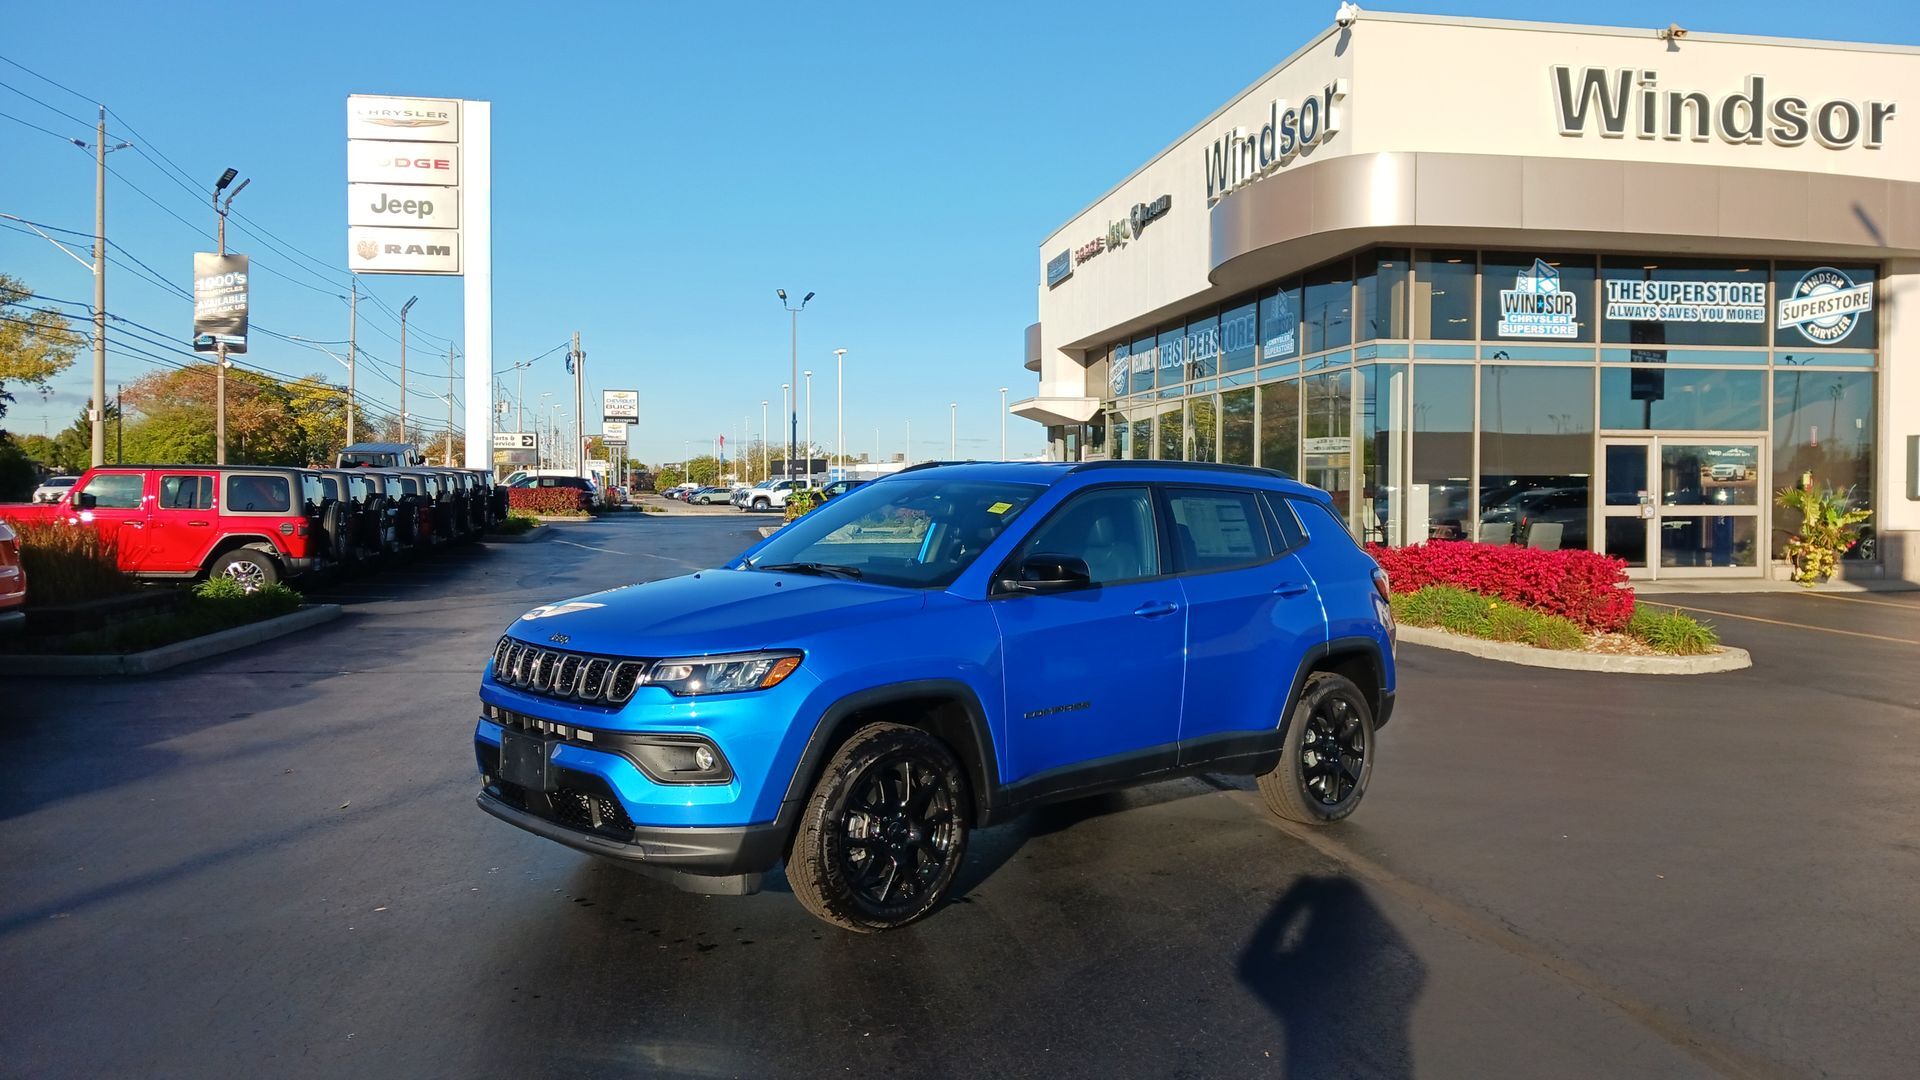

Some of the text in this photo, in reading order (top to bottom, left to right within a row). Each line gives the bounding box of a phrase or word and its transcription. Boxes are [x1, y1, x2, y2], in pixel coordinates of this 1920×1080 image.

[357, 109, 448, 119] HRYSLER
[1549, 64, 1897, 150] Windsor
[1203, 78, 1348, 202] Windsor
[378, 158, 450, 171] DGE
[370, 193, 434, 219] Jeep
[384, 244, 450, 256] RAM
[1609, 281, 1764, 304] THE SUPERSTORE
[1800, 272, 1845, 294] WINDSOR
[1503, 292, 1573, 315] WINDSOR
[1608, 305, 1764, 321] ALWAYS SAVES YOU MORE!
[1782, 292, 1869, 321] SUPERSTORE
[1501, 324, 1576, 335] SUPERSTORE
[1509, 314, 1568, 324] CHRYSLER
[1808, 316, 1852, 340] CHRYSLER
[1172, 315, 1257, 367] SUPERSTORE
